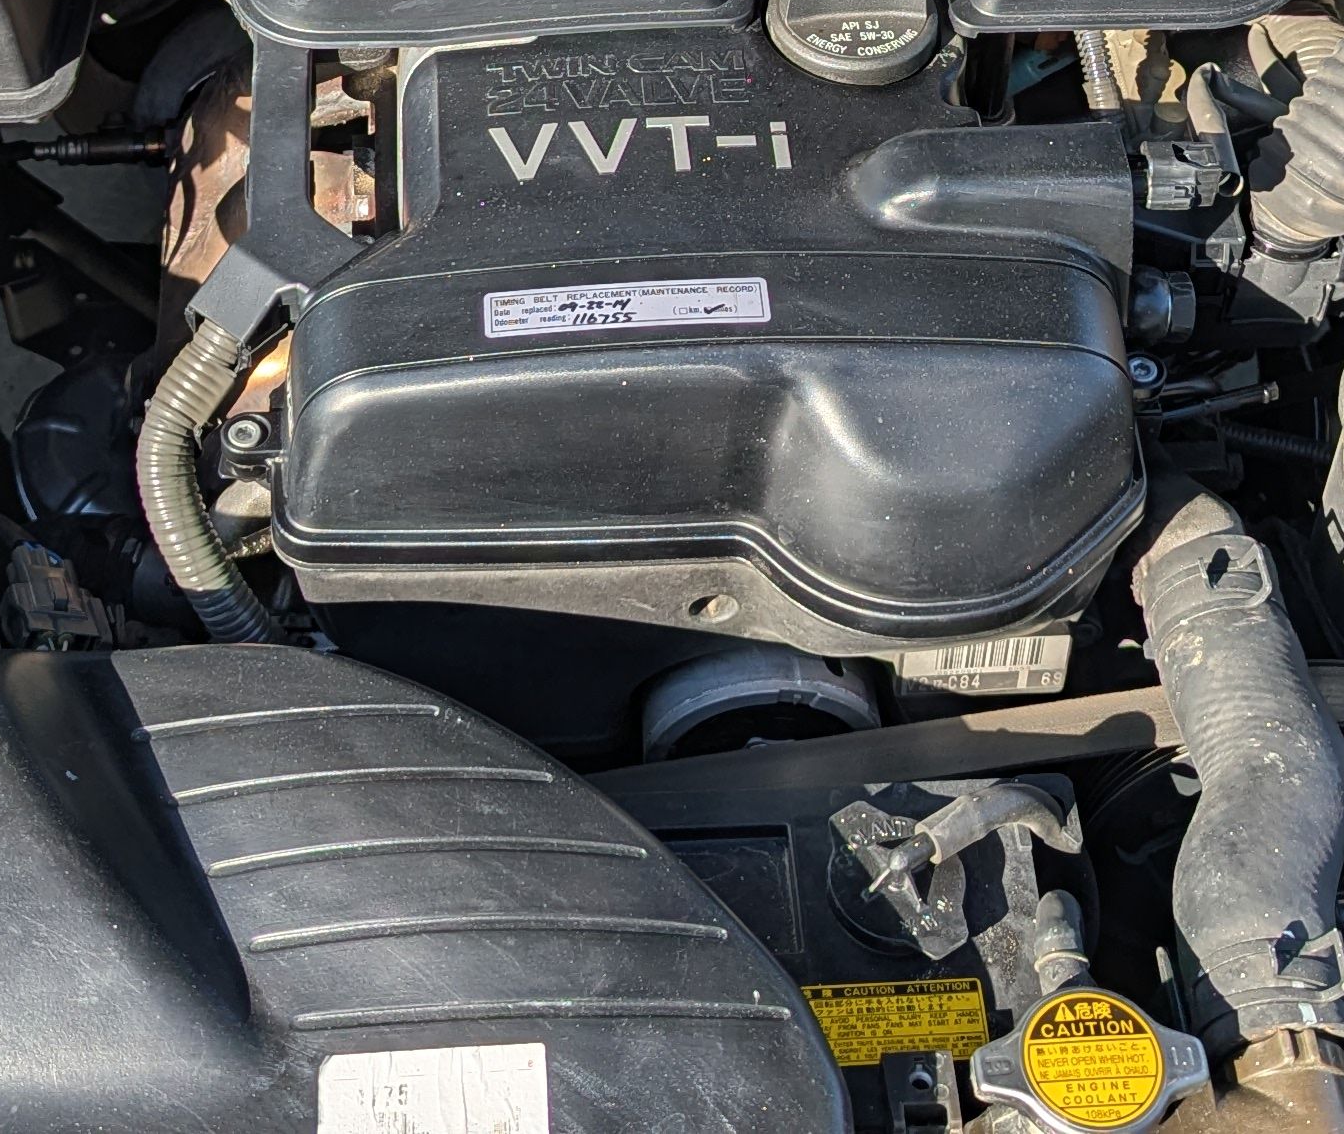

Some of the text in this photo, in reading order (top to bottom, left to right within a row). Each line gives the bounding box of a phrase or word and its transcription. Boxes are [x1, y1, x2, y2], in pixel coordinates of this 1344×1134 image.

[841, 20, 880, 31] API SJ
[805, 28, 919, 57] ENERGY CONSERVING
[830, 31, 895, 42] SAE 5W-30
[486, 48, 746, 86] TWIN CAM
[488, 115, 793, 182] VVT-i
[494, 298, 526, 308] TIMING
[534, 294, 558, 304] BELT
[844, 981, 971, 997] CAUTION ATTENTION
[1074, 1002, 1113, 1021] 危険
[1041, 1019, 1135, 1039] CAUTION
[1037, 1056, 1069, 1069] NEVER
[1071, 1054, 1098, 1067] OPEN
[1098, 1053, 1125, 1065] WHEN
[1039, 1070, 1051, 1080] NE
[1053, 1068, 1080, 1080] JAMAIS
[1083, 1066, 1113, 1078] OUVRIR
[1065, 1080, 1131, 1094] ENGINE
[1062, 1092, 1139, 1106] COOLANT
[1084, 1107, 1122, 1120] 108kPa
